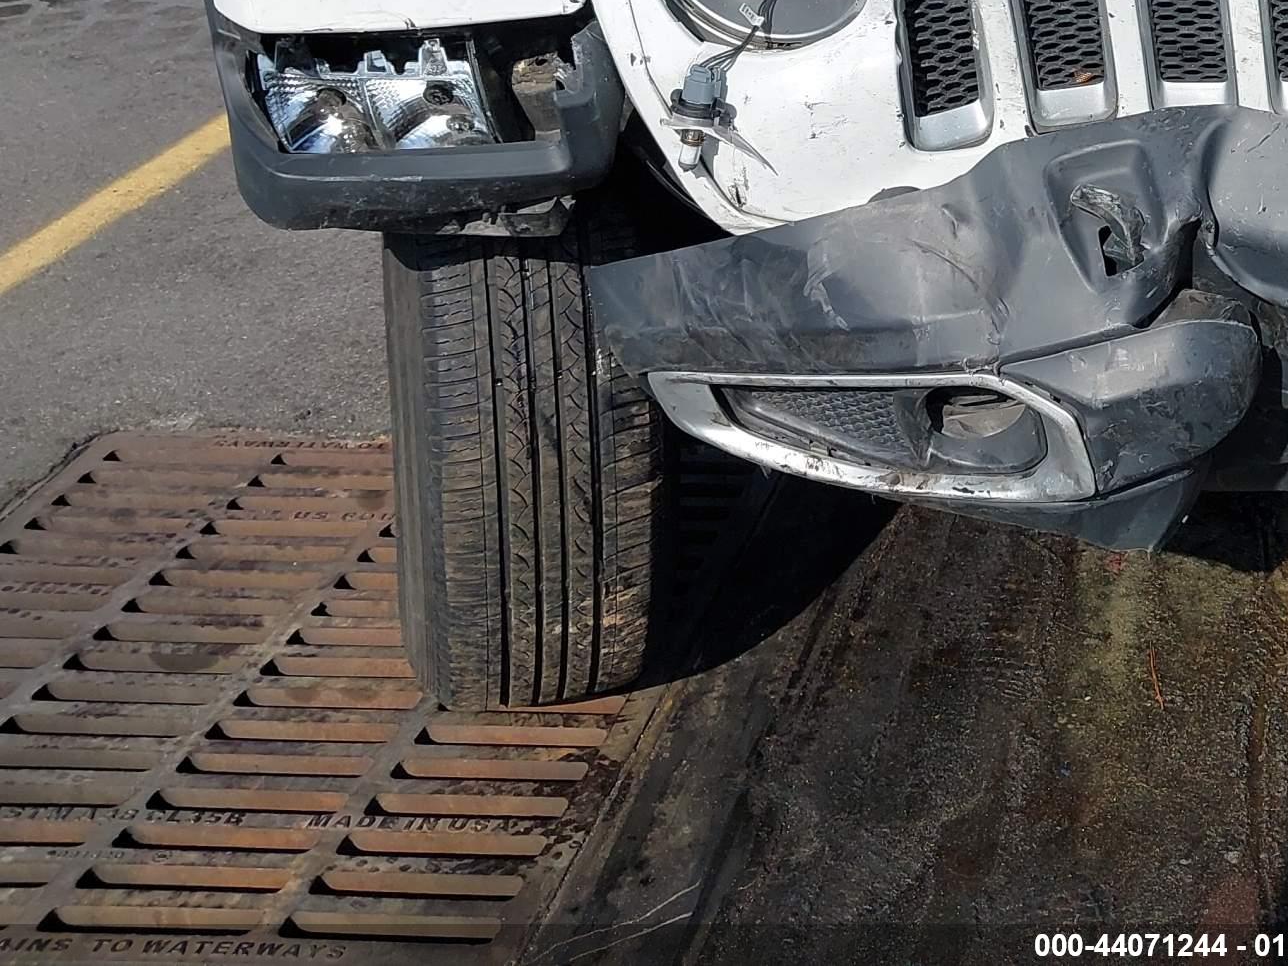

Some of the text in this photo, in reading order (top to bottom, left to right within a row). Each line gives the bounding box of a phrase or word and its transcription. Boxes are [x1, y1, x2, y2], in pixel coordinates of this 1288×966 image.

[306, 814, 516, 833] MADE IN USA
[92, 938, 133, 953] TO
[141, 940, 347, 960] WATERWAYS
